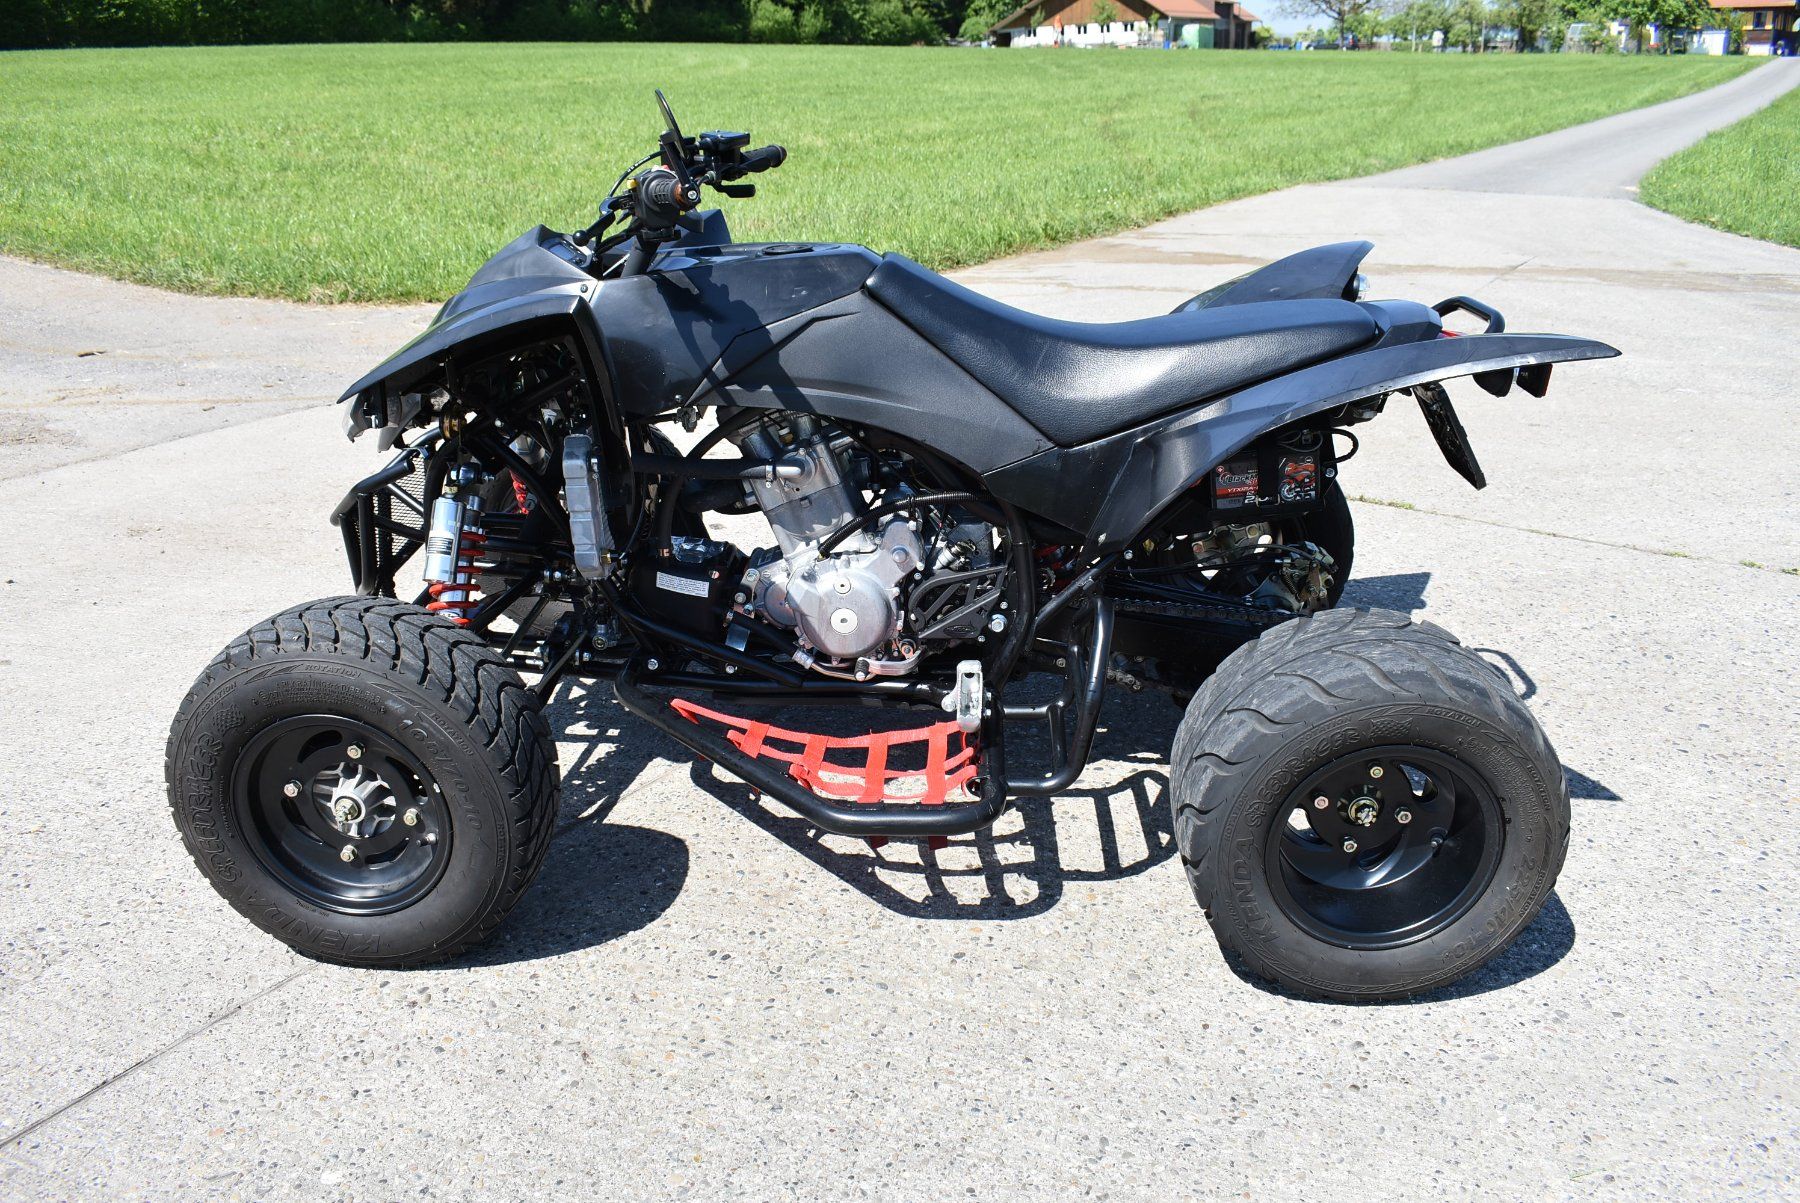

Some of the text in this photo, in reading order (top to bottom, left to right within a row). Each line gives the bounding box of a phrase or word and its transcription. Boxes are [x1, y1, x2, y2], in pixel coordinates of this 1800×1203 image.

[305, 663, 361, 678] ROTATION
[200, 681, 237, 714] ROTATION
[1427, 707, 1482, 728] ROTATION
[430, 712, 474, 757] ROTATION
[1527, 764, 1552, 811] ROTATION
[1231, 831, 1281, 943] KENDA
[238, 886, 381, 954] KENDA
